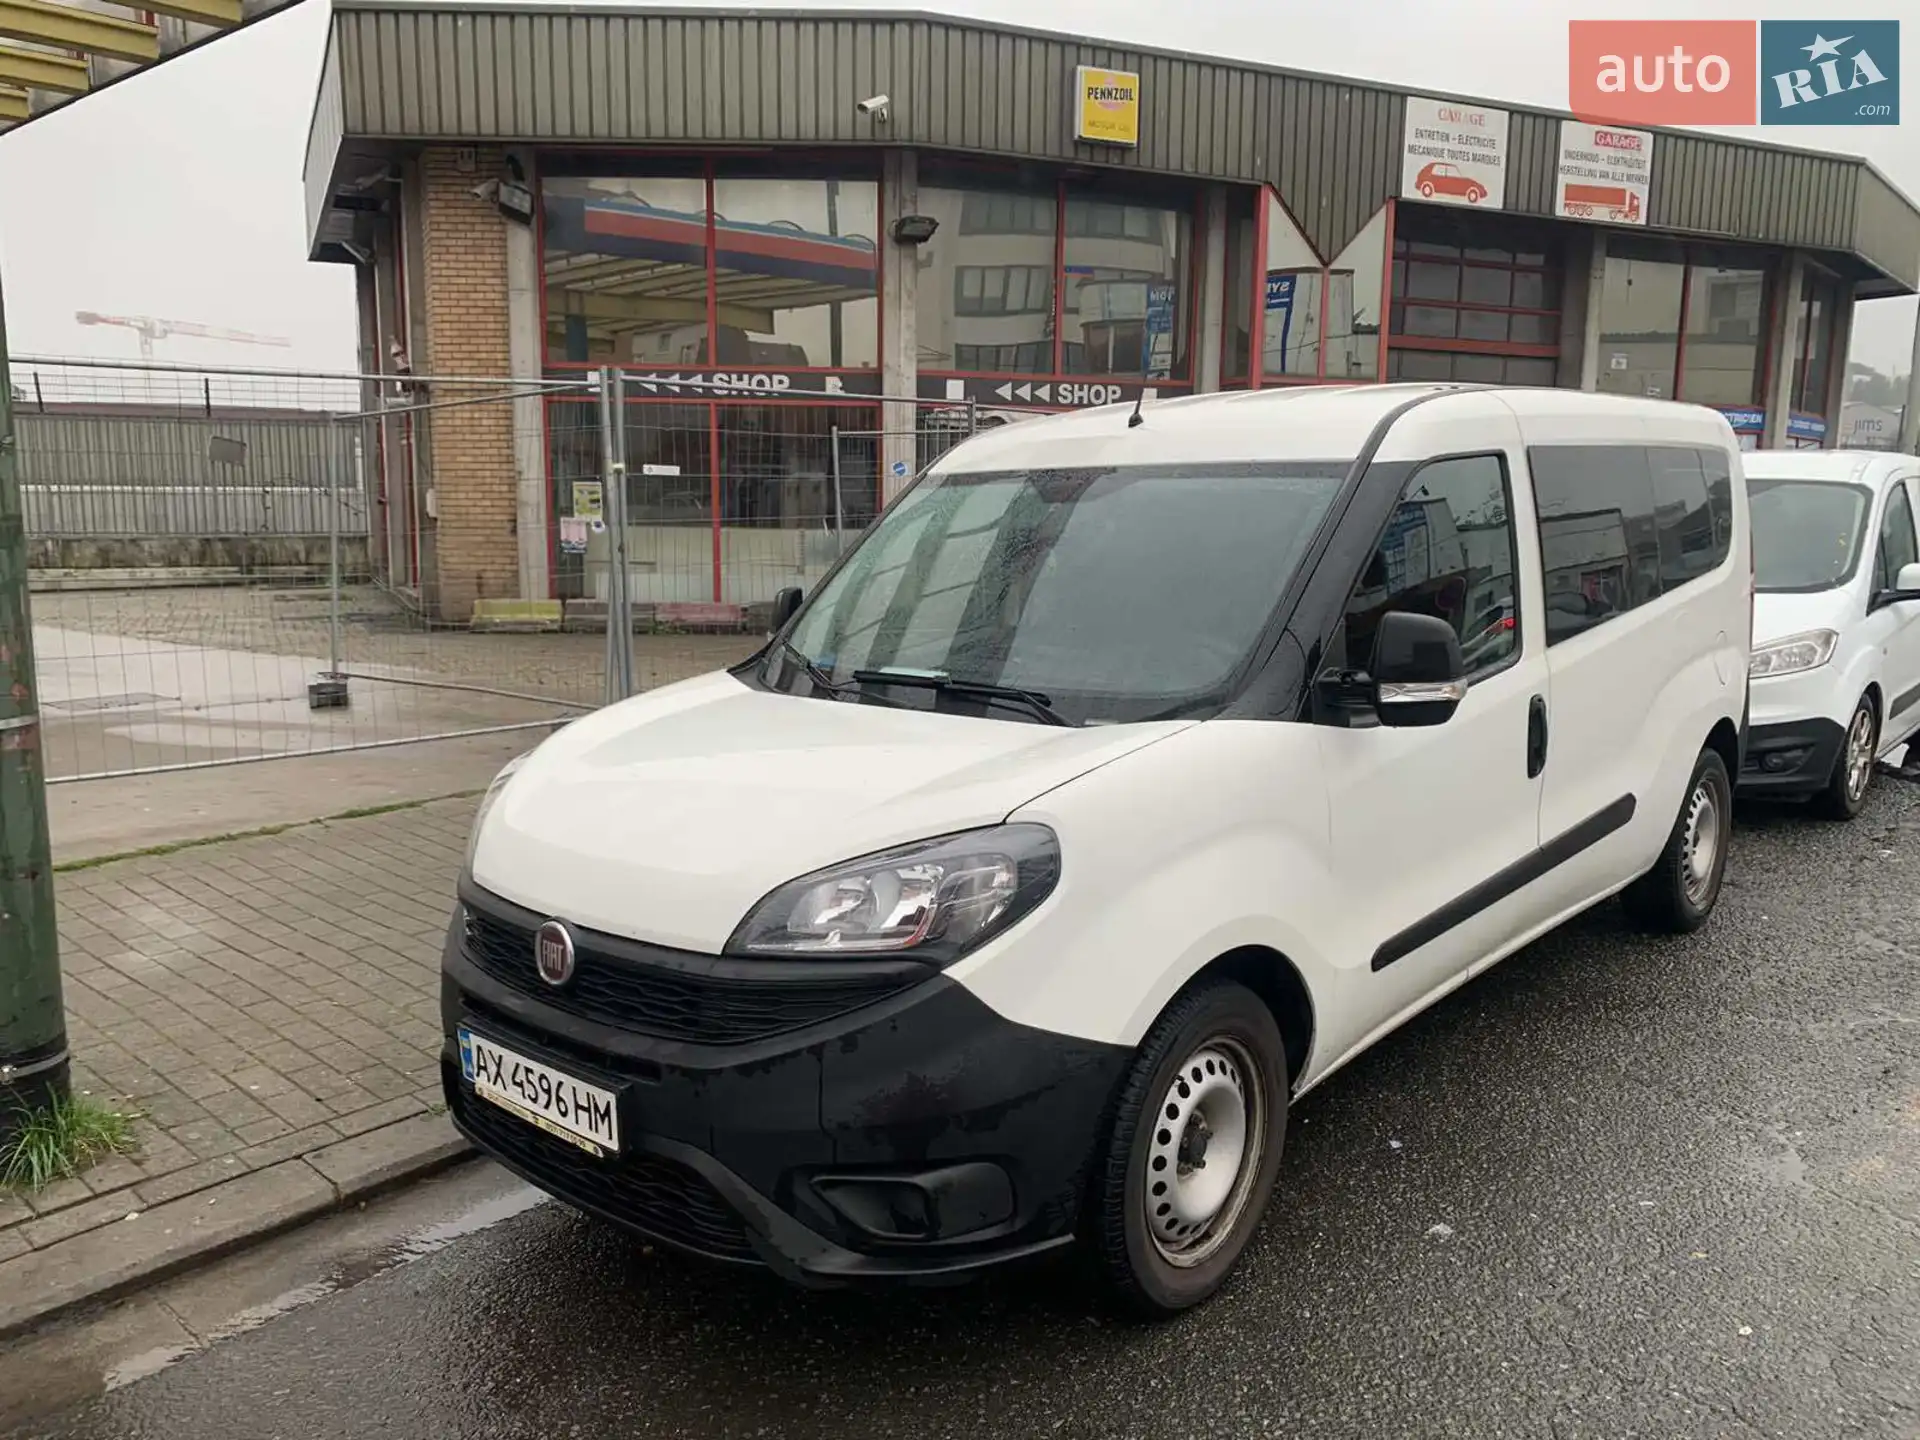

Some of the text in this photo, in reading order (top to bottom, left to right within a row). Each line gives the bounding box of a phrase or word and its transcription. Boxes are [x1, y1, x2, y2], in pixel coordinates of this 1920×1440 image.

[1087, 86, 1134, 101] PENNZOIL
[1414, 127, 1450, 143] ENTRETIEN
[1595, 131, 1643, 151] GARAGE
[1447, 147, 1471, 162] TOUTES
[1611, 170, 1626, 182] ALLE
[712, 372, 790, 396] SHOP
[1057, 382, 1122, 405] SHOP
[542, 939, 565, 971] FIAT
[475, 1044, 507, 1091] AX
[511, 1062, 569, 1118] 4596
[571, 1085, 614, 1141] HM
